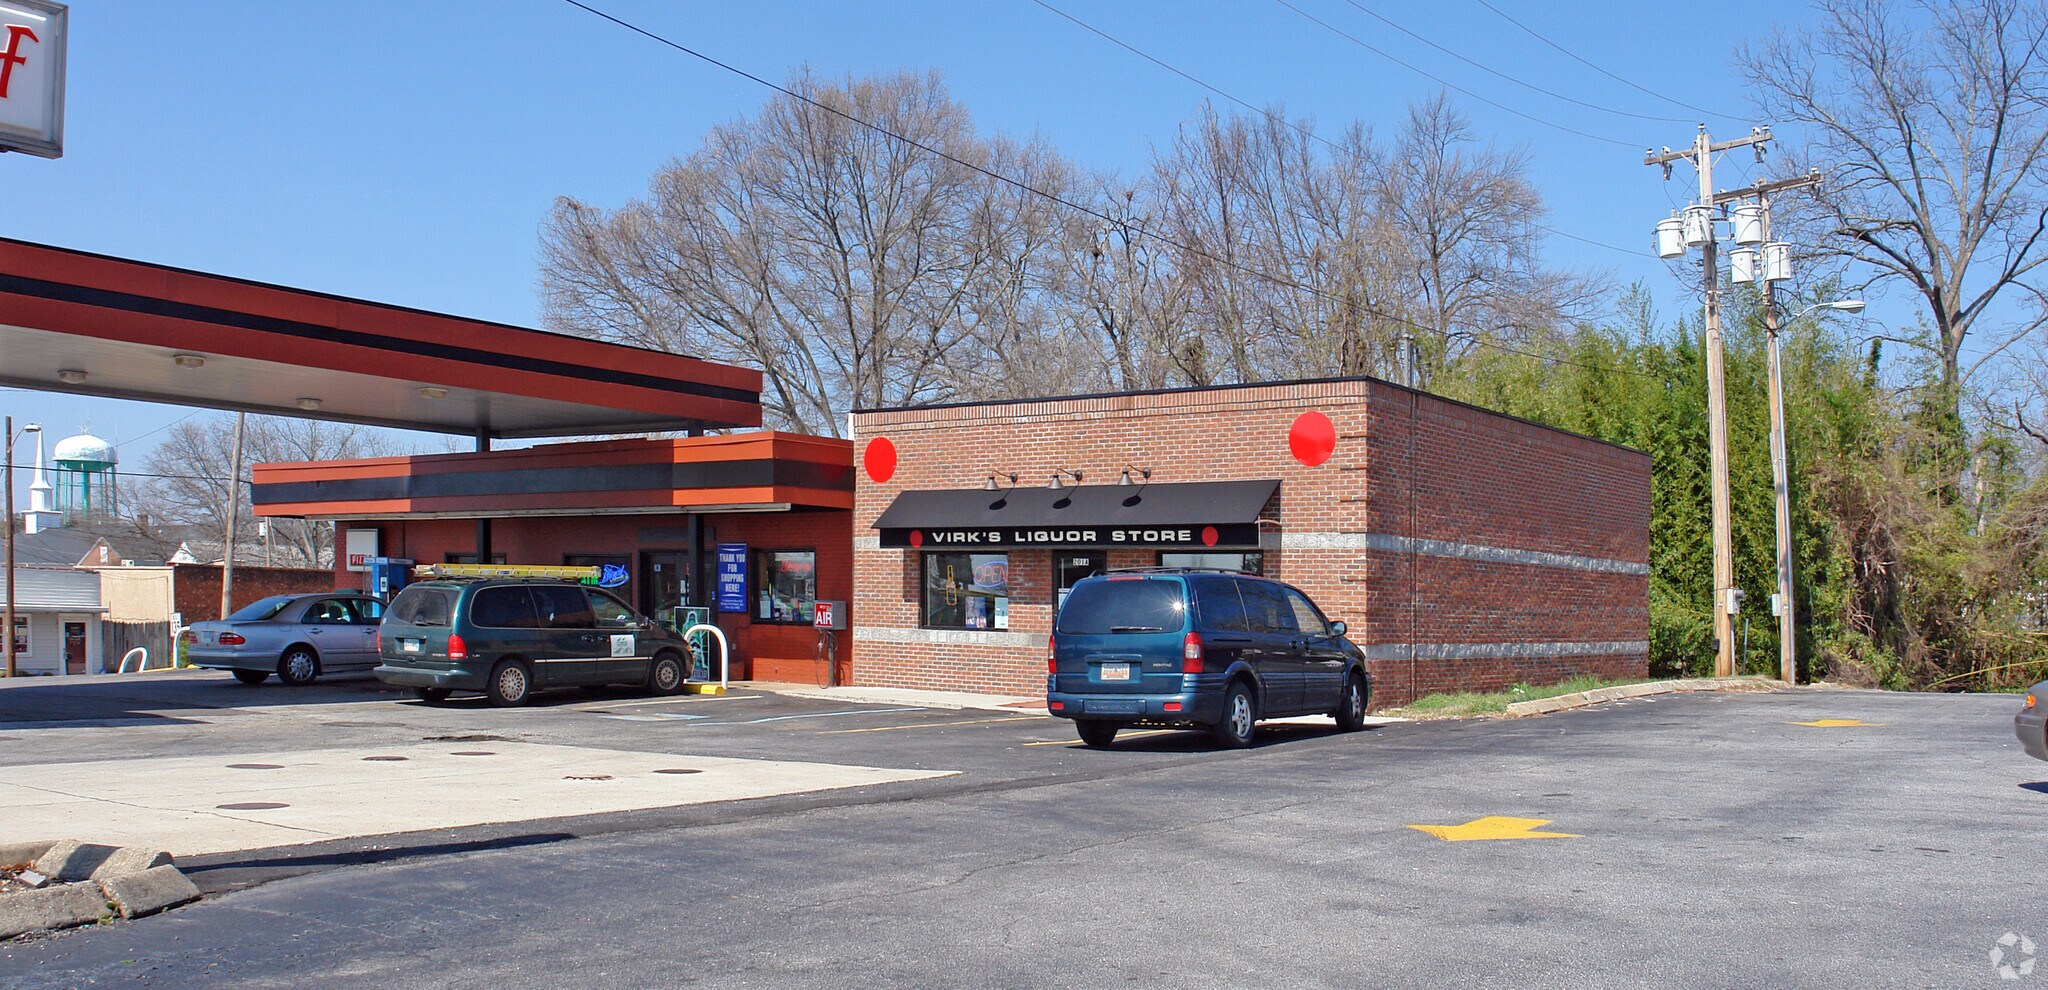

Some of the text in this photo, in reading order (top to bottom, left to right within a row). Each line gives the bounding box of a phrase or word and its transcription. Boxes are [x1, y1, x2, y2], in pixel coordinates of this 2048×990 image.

[932, 529, 1191, 543] VIRK'S LIQUOR STORE
[719, 553, 746, 563] THANK YOU
[727, 563, 738, 573] FOR
[720, 573, 744, 583] SHOPPING
[974, 565, 1008, 583] OPEN
[725, 583, 740, 593] HERE!
[815, 611, 832, 625] AIR
